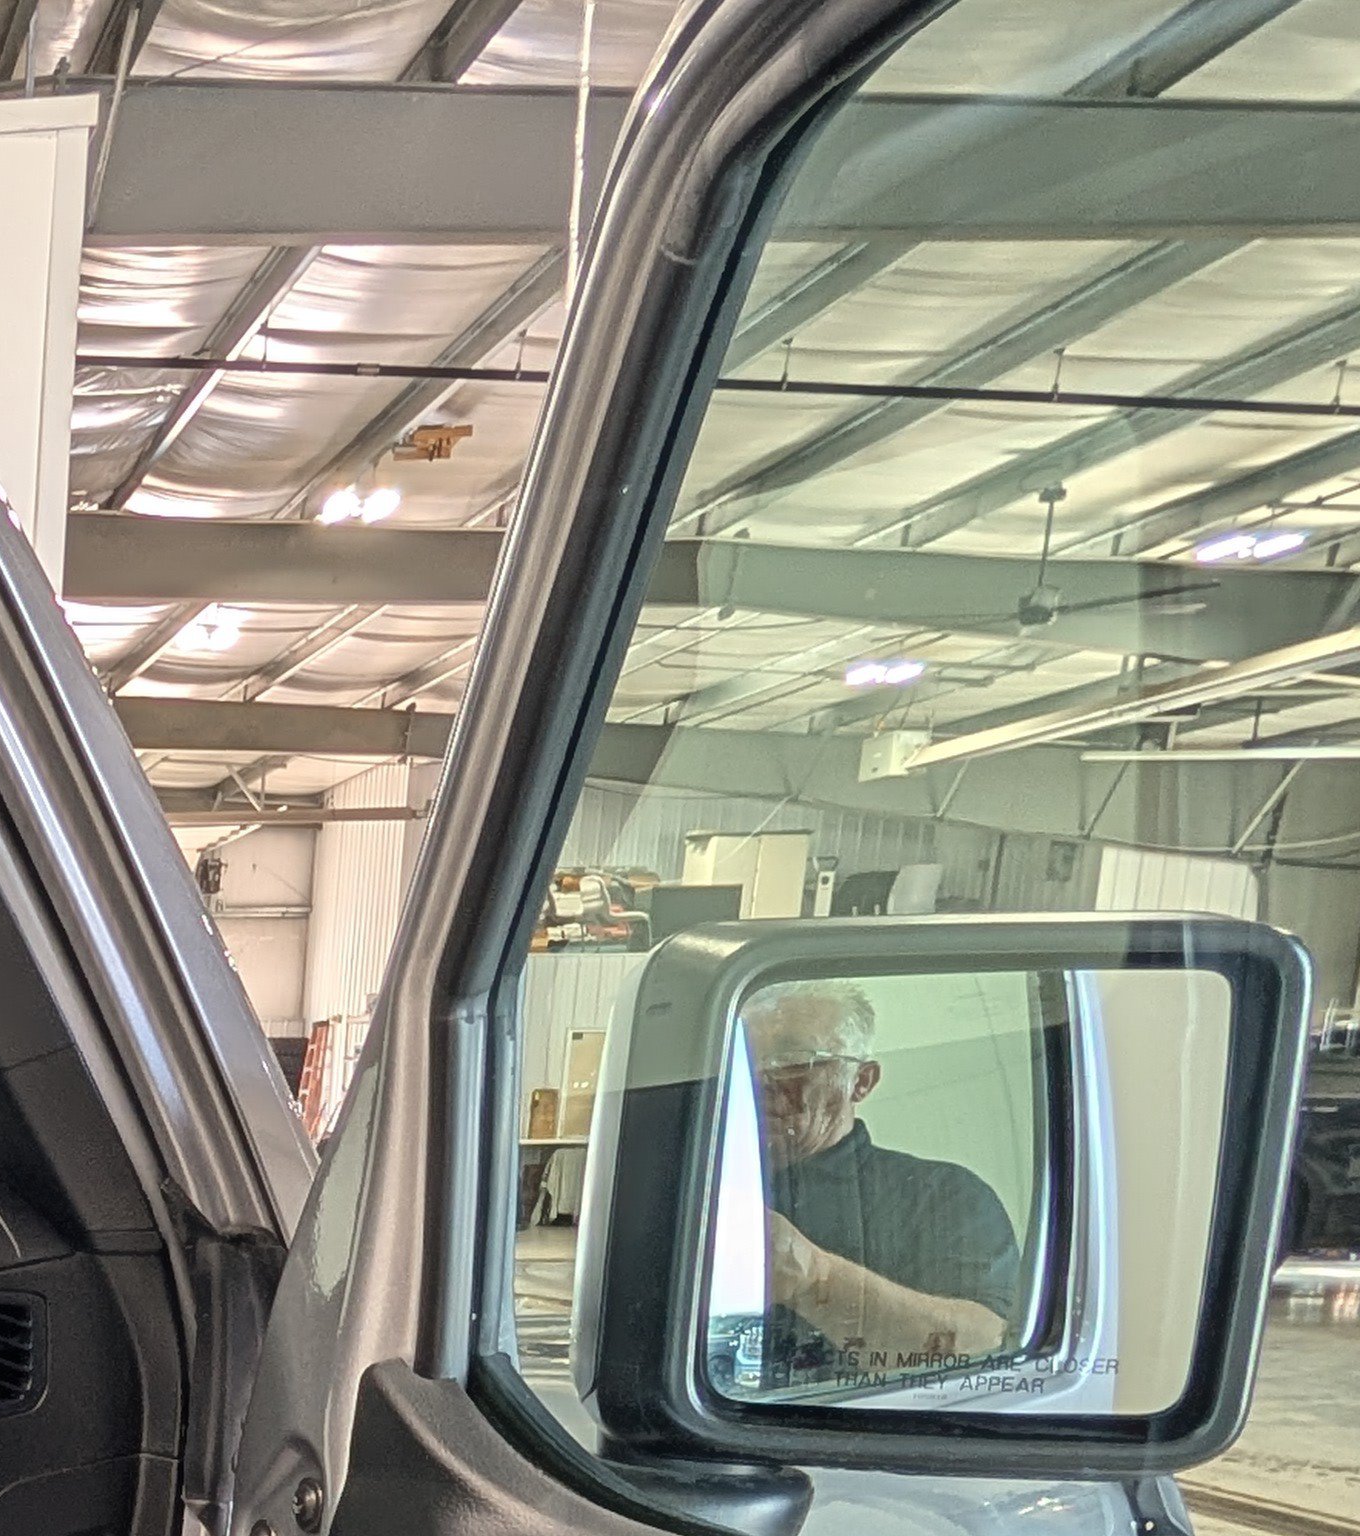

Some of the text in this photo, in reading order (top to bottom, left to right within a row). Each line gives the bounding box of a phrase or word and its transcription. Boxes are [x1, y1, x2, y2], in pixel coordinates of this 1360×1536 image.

[870, 1351, 887, 1367] IN
[896, 1352, 970, 1370] MIRROR
[981, 1354, 1021, 1371] ARE
[834, 1371, 1045, 1394] THAN THEY APPEAR
